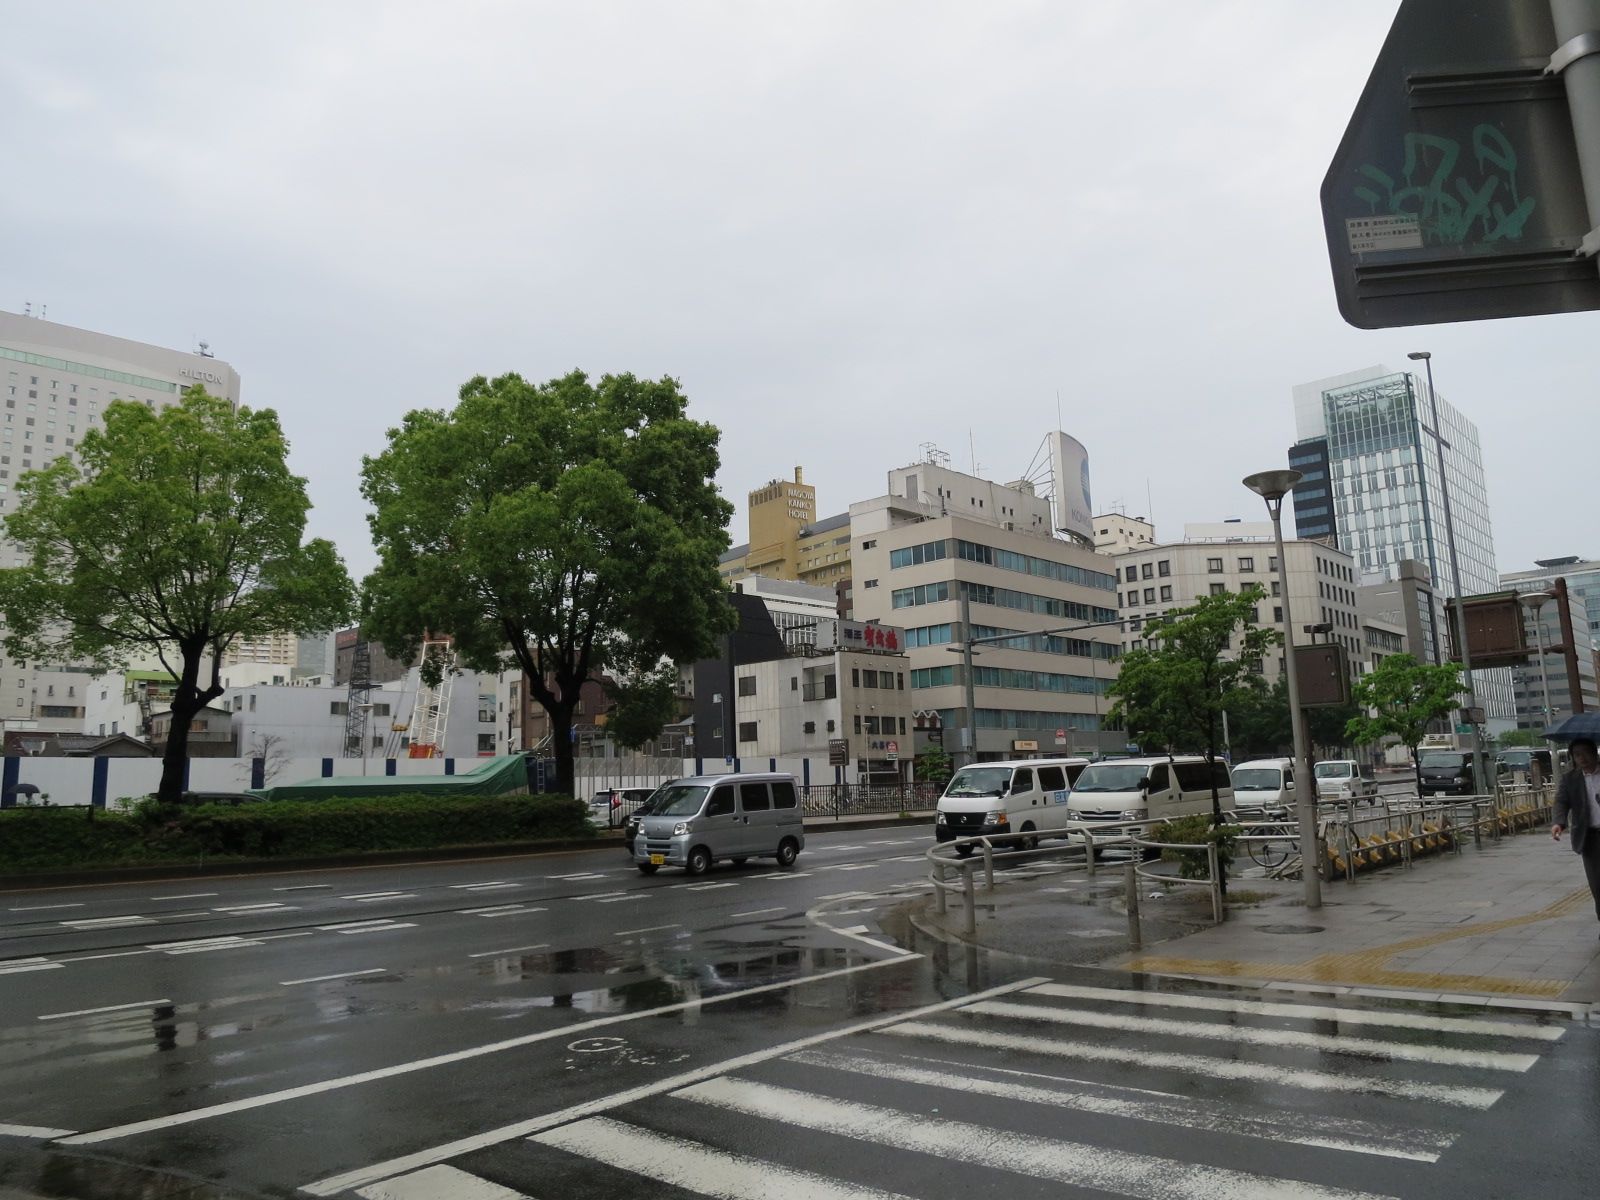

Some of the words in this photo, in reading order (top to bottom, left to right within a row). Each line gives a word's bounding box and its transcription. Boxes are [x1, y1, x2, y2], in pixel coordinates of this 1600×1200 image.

[179, 367, 222, 385] HILTON
[787, 488, 814, 501] NAGOYA
[787, 498, 812, 510] KANKO
[787, 508, 809, 520] HOTEL
